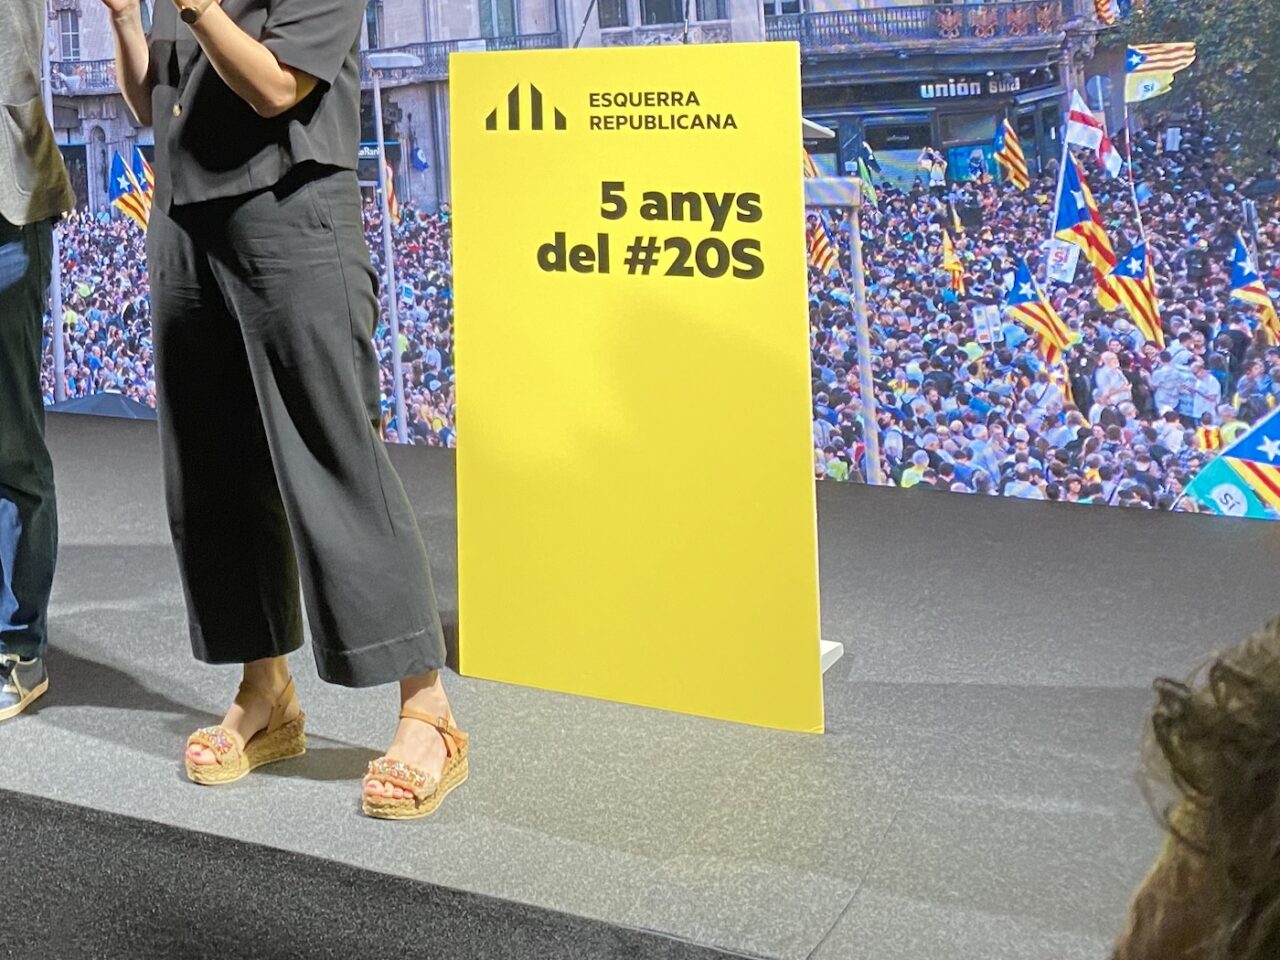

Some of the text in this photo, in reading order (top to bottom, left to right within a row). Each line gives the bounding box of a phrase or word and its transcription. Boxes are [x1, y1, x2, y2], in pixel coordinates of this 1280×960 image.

[920, 78, 982, 99] unión
[589, 91, 700, 108] ESQUERRA
[589, 114, 738, 131] REPUBLICANA
[600, 181, 763, 232] 5 anys
[537, 231, 765, 280] del #20S
